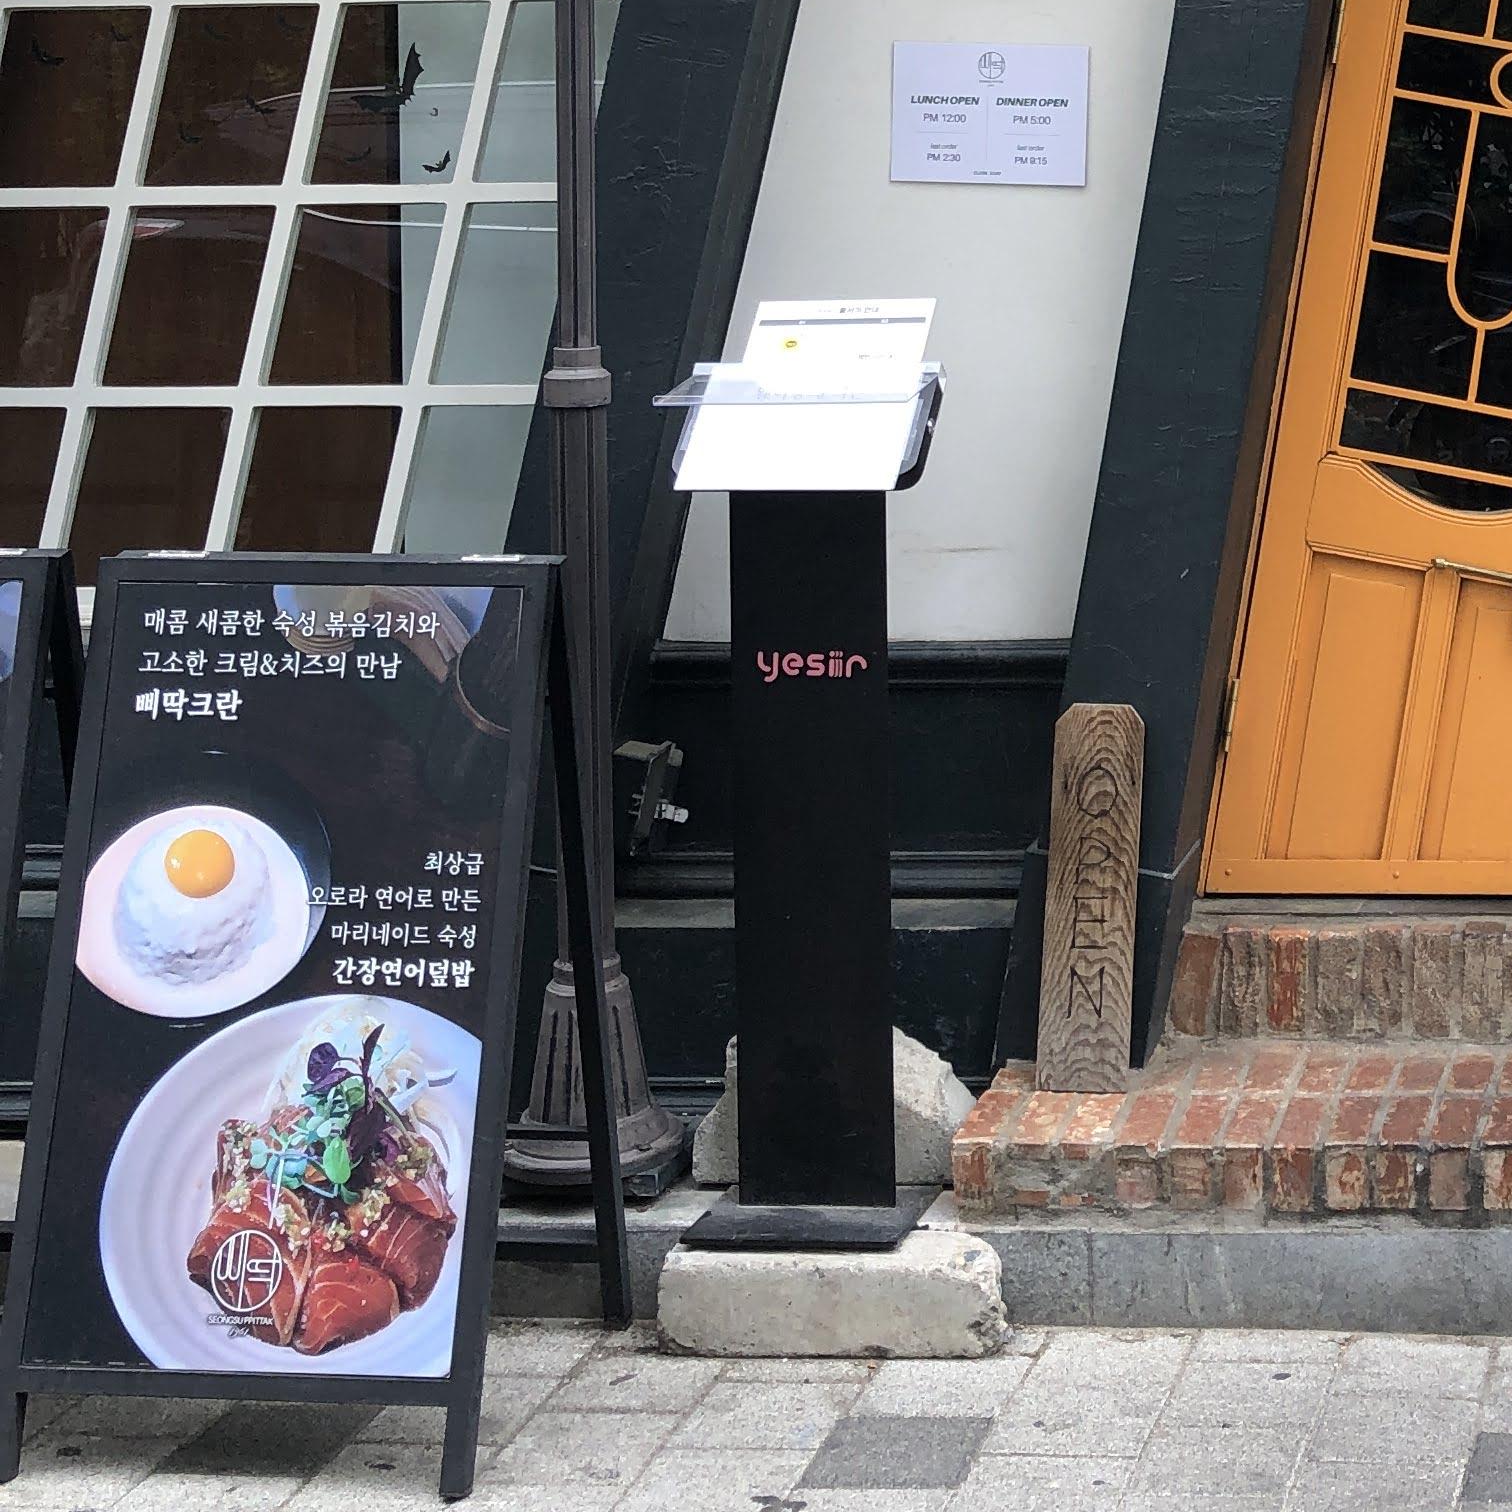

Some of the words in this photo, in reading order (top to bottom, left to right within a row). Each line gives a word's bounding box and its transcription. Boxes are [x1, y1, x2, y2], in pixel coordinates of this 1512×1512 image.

[910, 95, 950, 106] LUNCH
[950, 96, 981, 106] OPEN
[995, 96, 1038, 108] DINNER
[1038, 98, 1069, 108] OPEN
[923, 113, 939, 123] PM
[941, 113, 967, 124] 12:00
[1012, 115, 1029, 126] PM
[926, 152, 941, 162] PM
[1014, 156, 1029, 165] PM
[144, 609, 190, 636] 매콤
[196, 609, 265, 637] 새콤한
[271, 609, 316, 638] 숙성
[325, 610, 441, 640] 볶음김치와
[137, 649, 208, 677] 고소한
[213, 650, 348, 680] 크림&치즈의
[356, 652, 402, 681] 만남
[134, 687, 243, 722] 삐딱크란
[424, 850, 485, 876] 최상급
[307, 884, 369, 910] 오로라
[374, 885, 435, 911] 연어로
[441, 887, 482, 912] 만든
[1066, 765, 1119, 1021] OPEN
[331, 921, 431, 948] 마리네이드
[437, 924, 477, 949] 숙성
[332, 956, 476, 989] 간장연어덮밥
